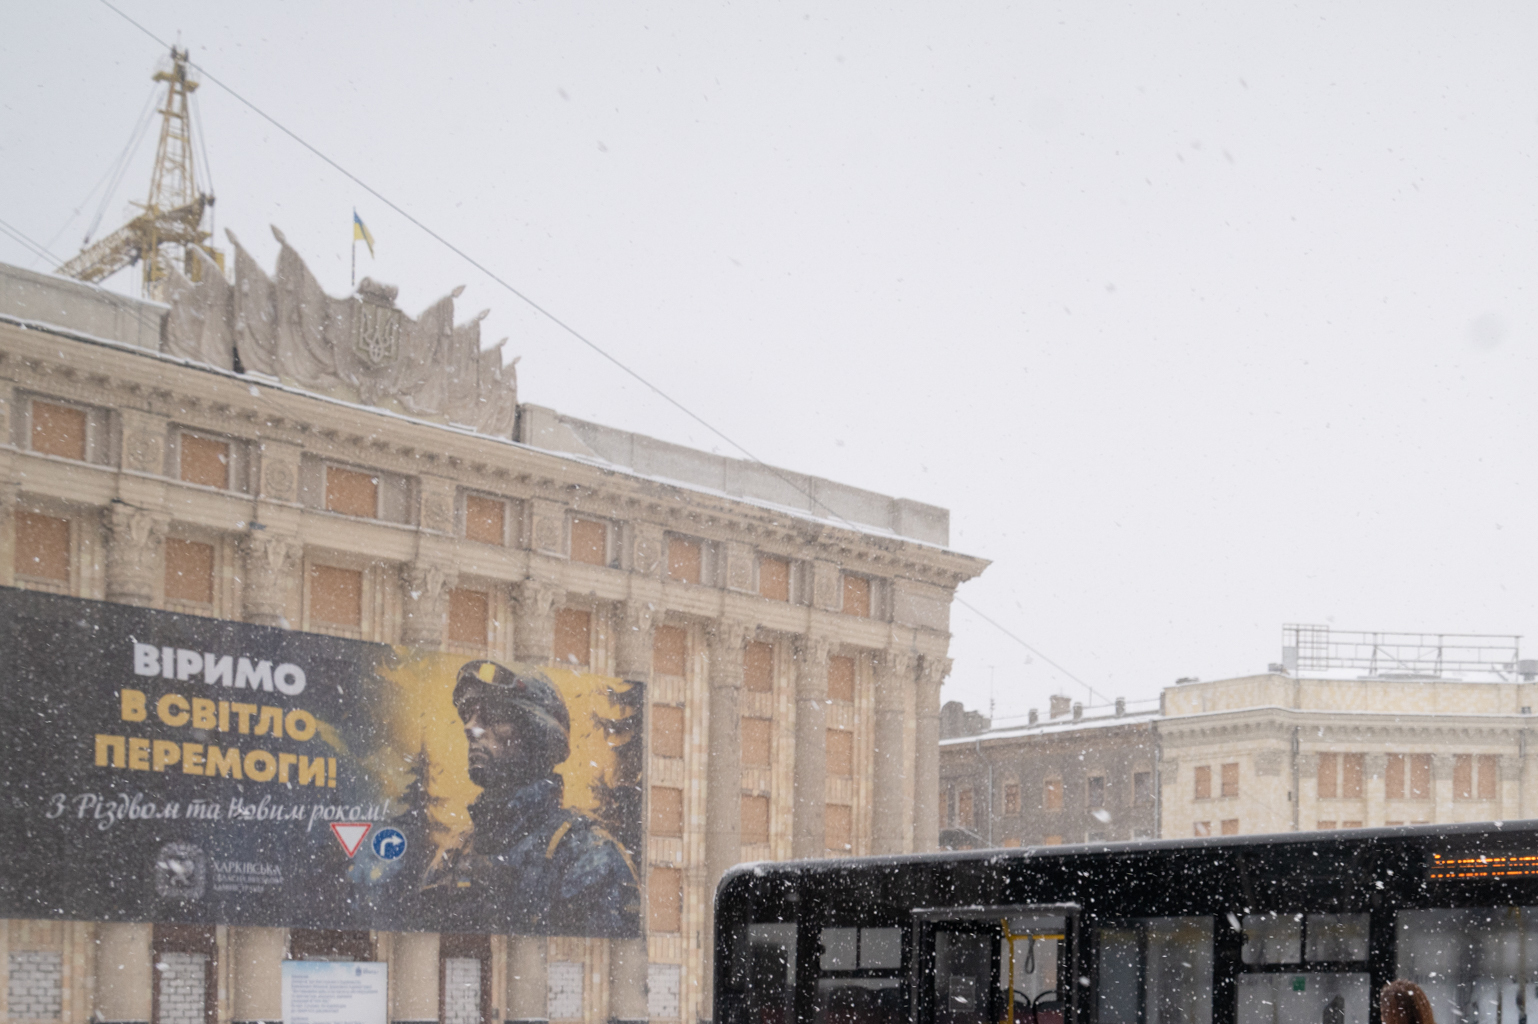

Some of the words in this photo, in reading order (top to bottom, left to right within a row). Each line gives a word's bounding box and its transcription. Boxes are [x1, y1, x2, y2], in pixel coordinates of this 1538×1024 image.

[133, 642, 306, 695] ВІРИМО
[121, 688, 147, 722] В
[156, 693, 317, 741] СВІТЛО
[94, 734, 337, 788] ПЕРЕМОГИ!
[46, 792, 66, 819] З
[72, 792, 181, 831] Різдвом
[185, 799, 222, 820] та
[228, 794, 306, 821] Новим
[306, 799, 390, 832] роком!
